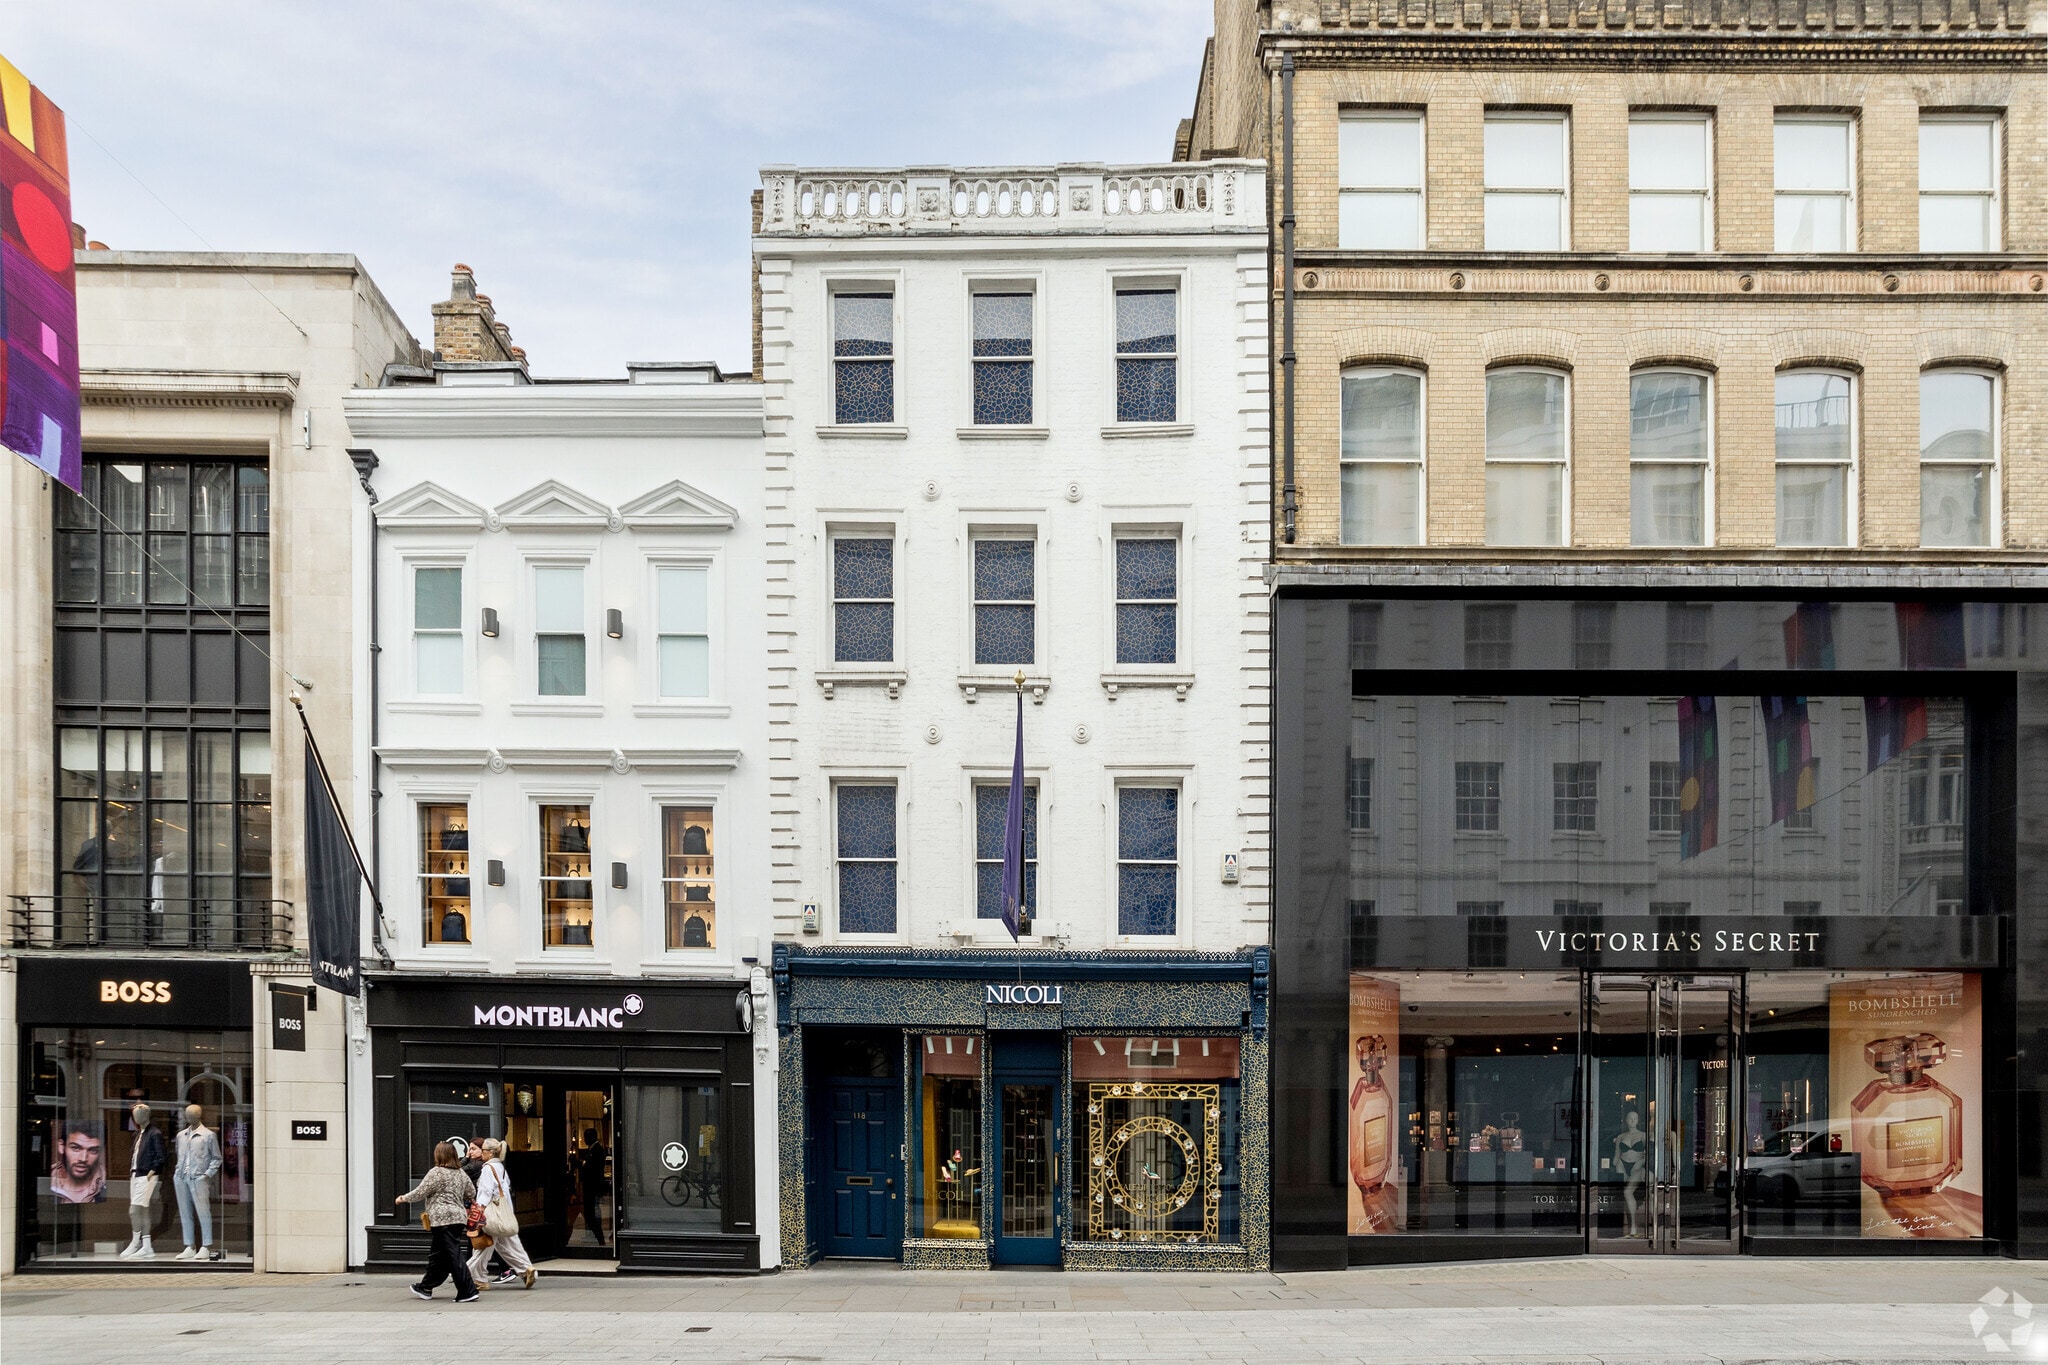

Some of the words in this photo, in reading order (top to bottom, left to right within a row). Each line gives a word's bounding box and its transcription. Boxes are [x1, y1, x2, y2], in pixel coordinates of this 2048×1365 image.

[1536, 930, 1701, 952] VICTORIA'S
[1715, 930, 1820, 952] SECRET
[100, 980, 172, 1003] BOSS
[986, 985, 1062, 1004] NICOLI
[1350, 993, 1392, 1012] BOMBSHELL
[1848, 993, 1959, 1012] BOMBSHELL
[474, 1005, 623, 1029] MONTBLANC
[1868, 1008, 1937, 1019] SUNDRENCHED
[279, 1017, 302, 1031] BOSS
[853, 1111, 866, 1120] 118
[296, 1126, 322, 1135] BOSS
[926, 1190, 964, 1201] NICOLI
[1865, 1218, 1887, 1231] Let
